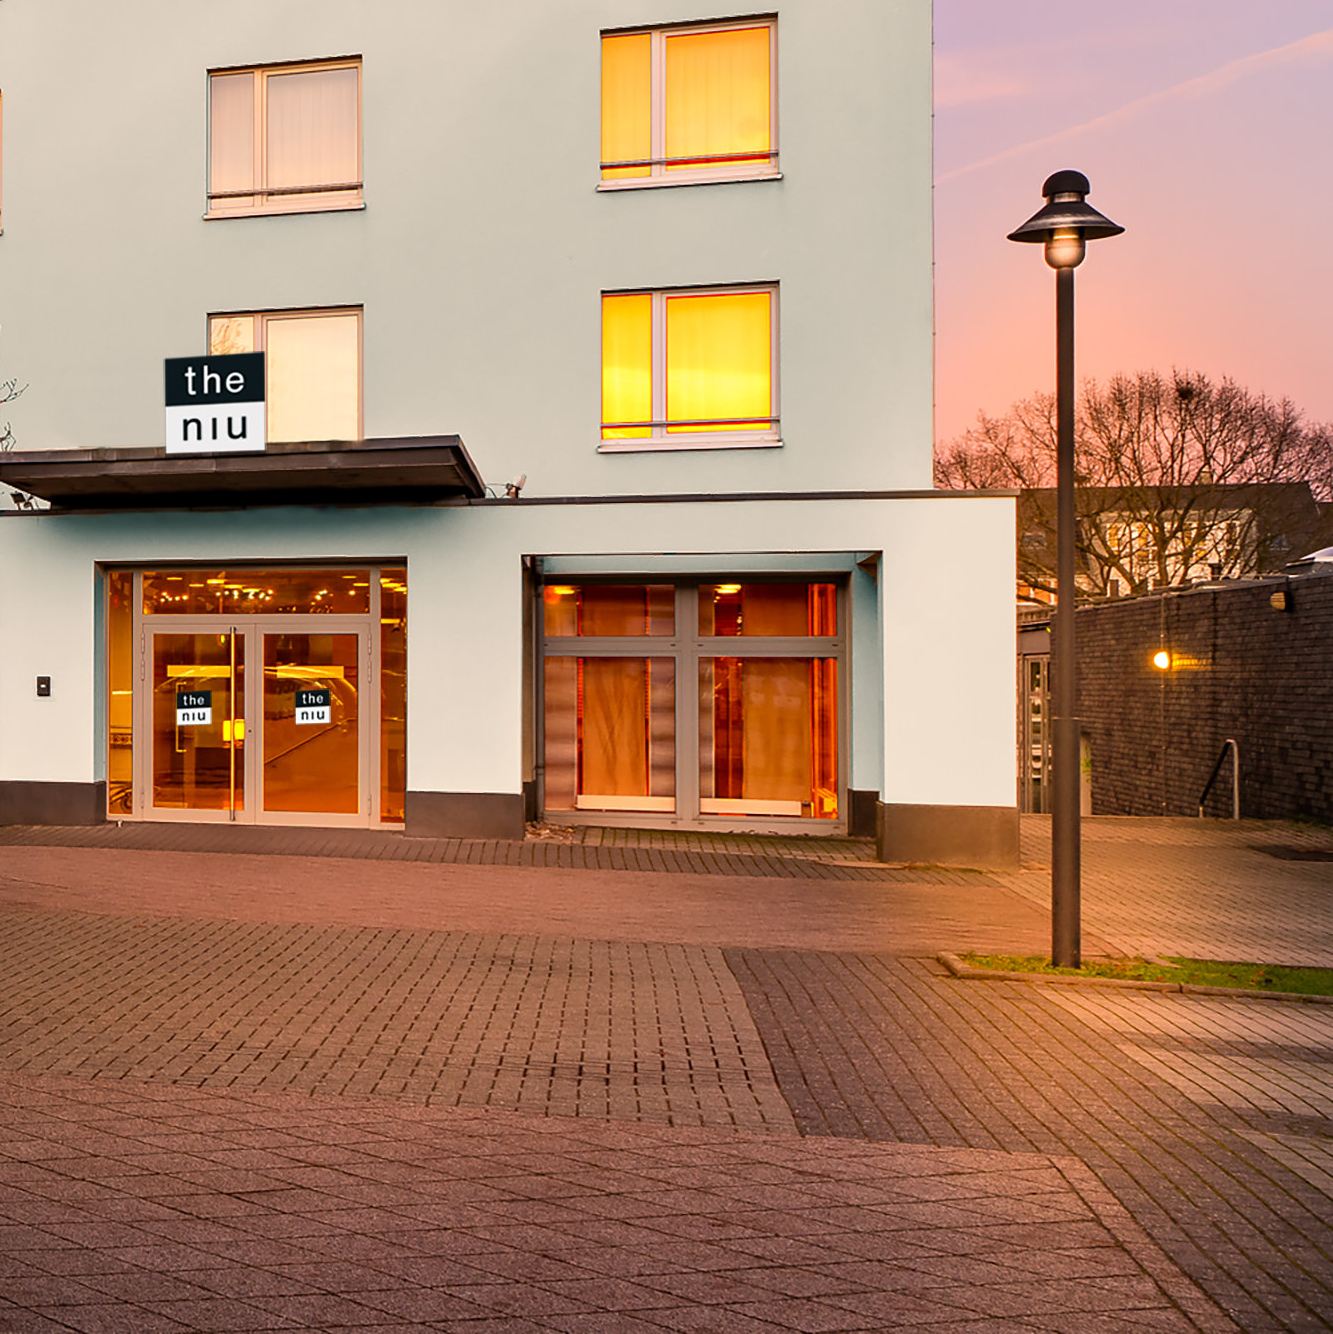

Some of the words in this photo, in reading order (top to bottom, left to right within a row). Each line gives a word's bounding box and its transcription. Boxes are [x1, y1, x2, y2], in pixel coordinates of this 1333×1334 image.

[184, 365, 245, 395] the
[183, 694, 205, 706] the
[301, 693, 324, 704] the
